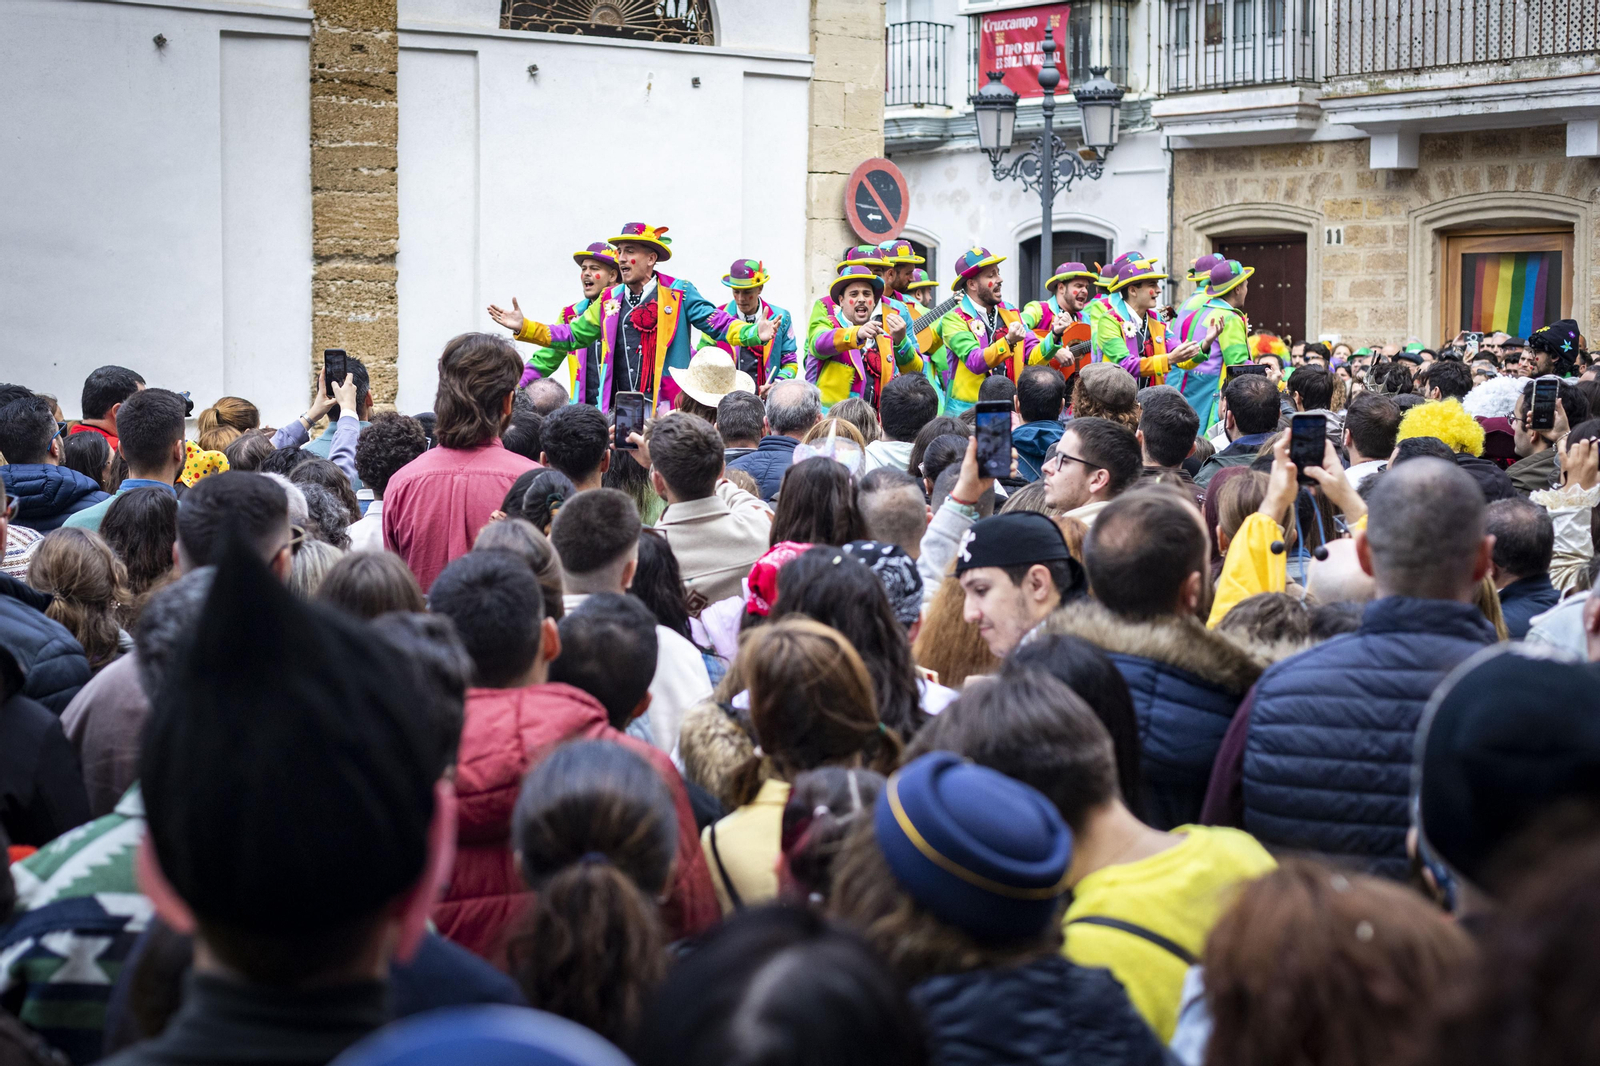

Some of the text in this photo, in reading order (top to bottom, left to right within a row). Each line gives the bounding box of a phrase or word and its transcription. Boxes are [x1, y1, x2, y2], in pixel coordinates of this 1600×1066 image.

[983, 16, 1038, 33] Cruzcampo
[1005, 42, 1022, 56] TIPO
[1023, 41, 1035, 54] SIN
[1326, 228, 1341, 244] 11
